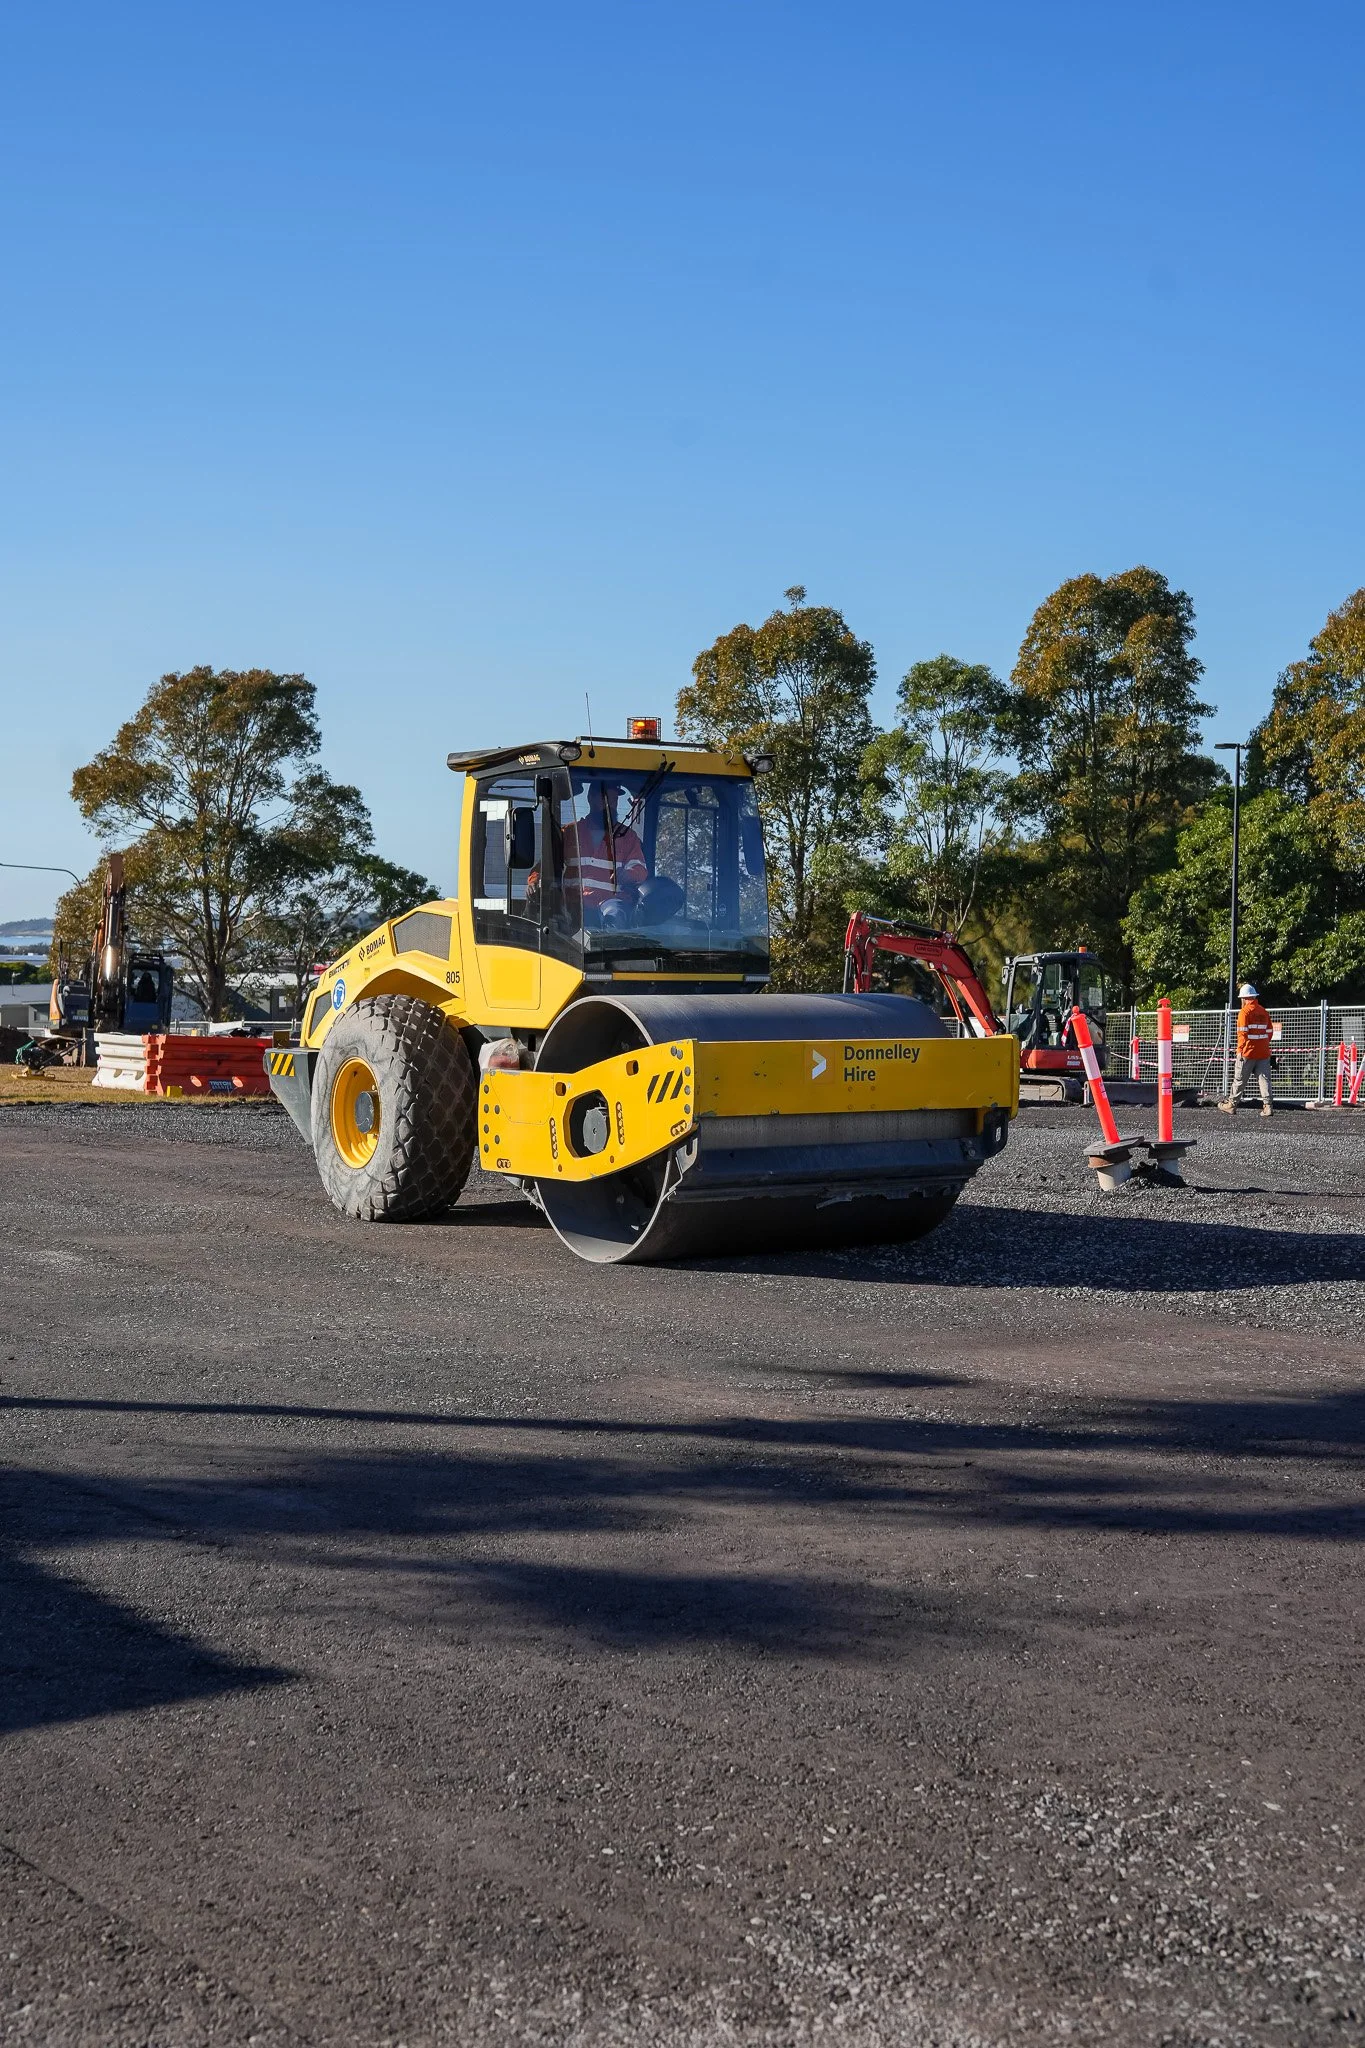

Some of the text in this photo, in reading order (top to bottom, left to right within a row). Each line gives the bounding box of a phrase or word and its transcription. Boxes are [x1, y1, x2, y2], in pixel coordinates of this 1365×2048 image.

[366, 935, 386, 955] BOMAG
[446, 971, 460, 984] 805
[844, 1044, 921, 1065] Donnelley
[844, 1066, 876, 1082] Hire
